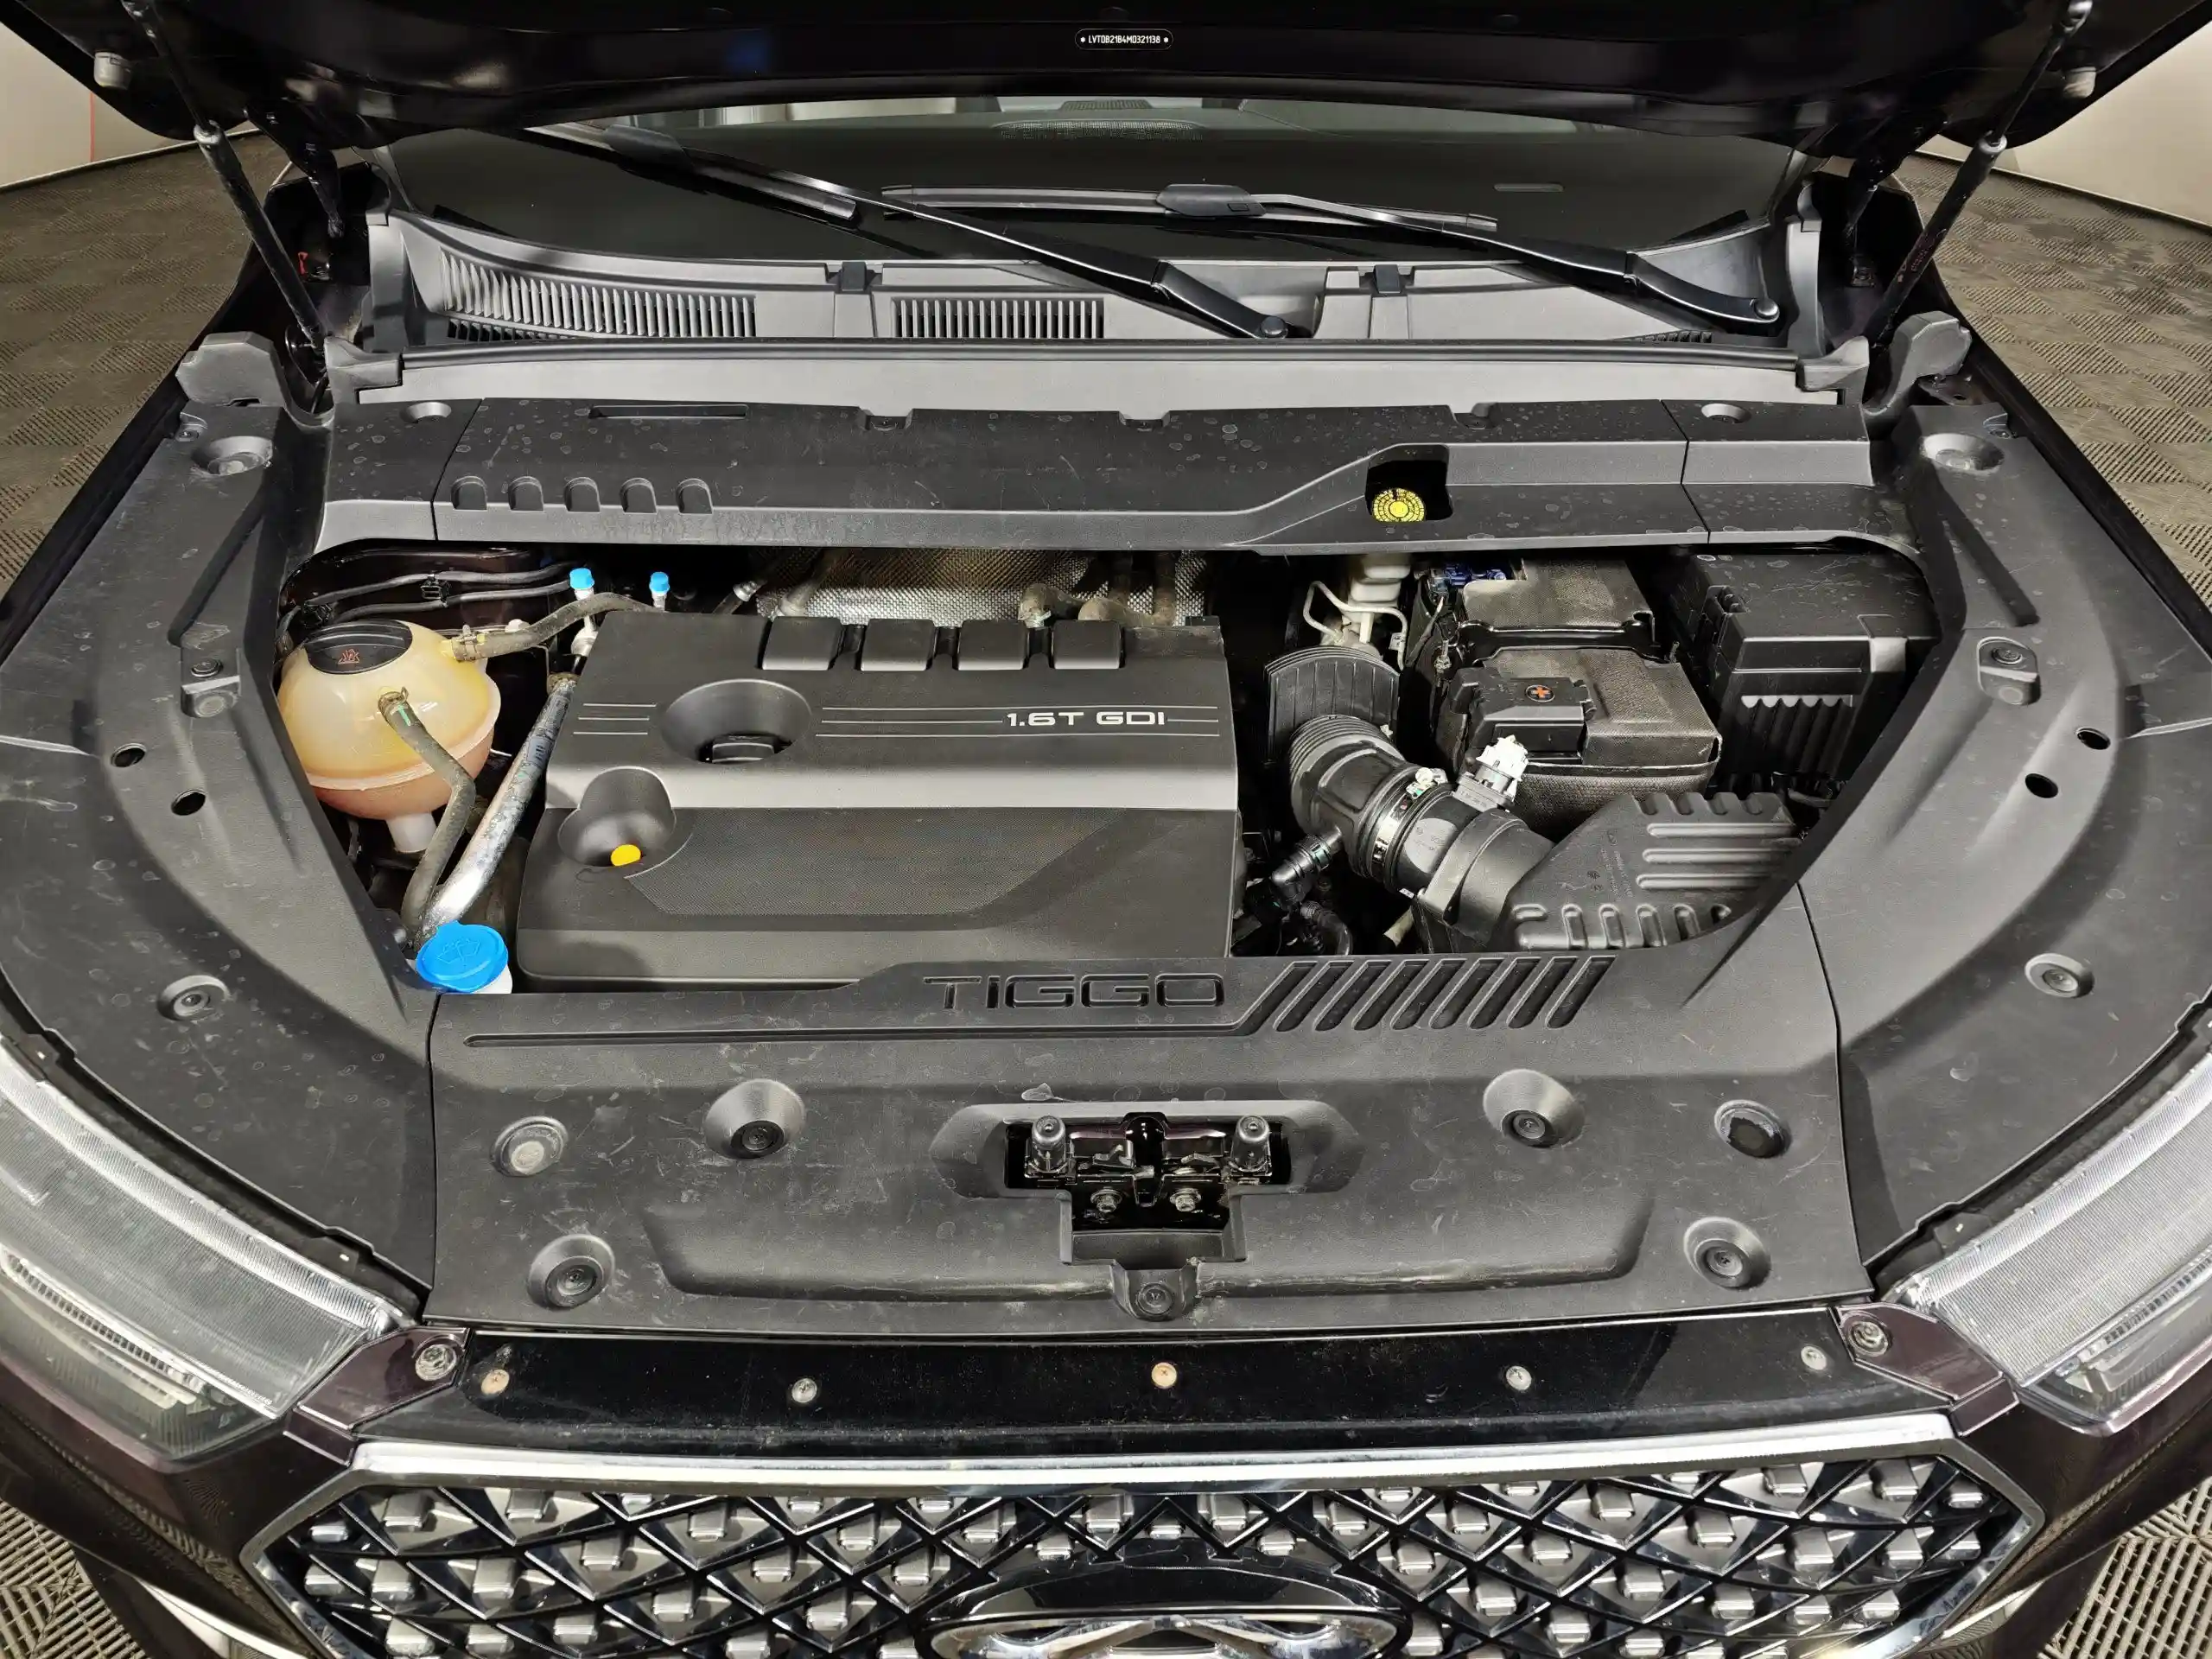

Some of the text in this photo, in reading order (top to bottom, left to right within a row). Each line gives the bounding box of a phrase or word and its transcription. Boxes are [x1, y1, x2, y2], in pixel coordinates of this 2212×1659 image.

[1007, 711, 1166, 727] 1.6T GDI
[923, 973, 1225, 1009] TIGGO
